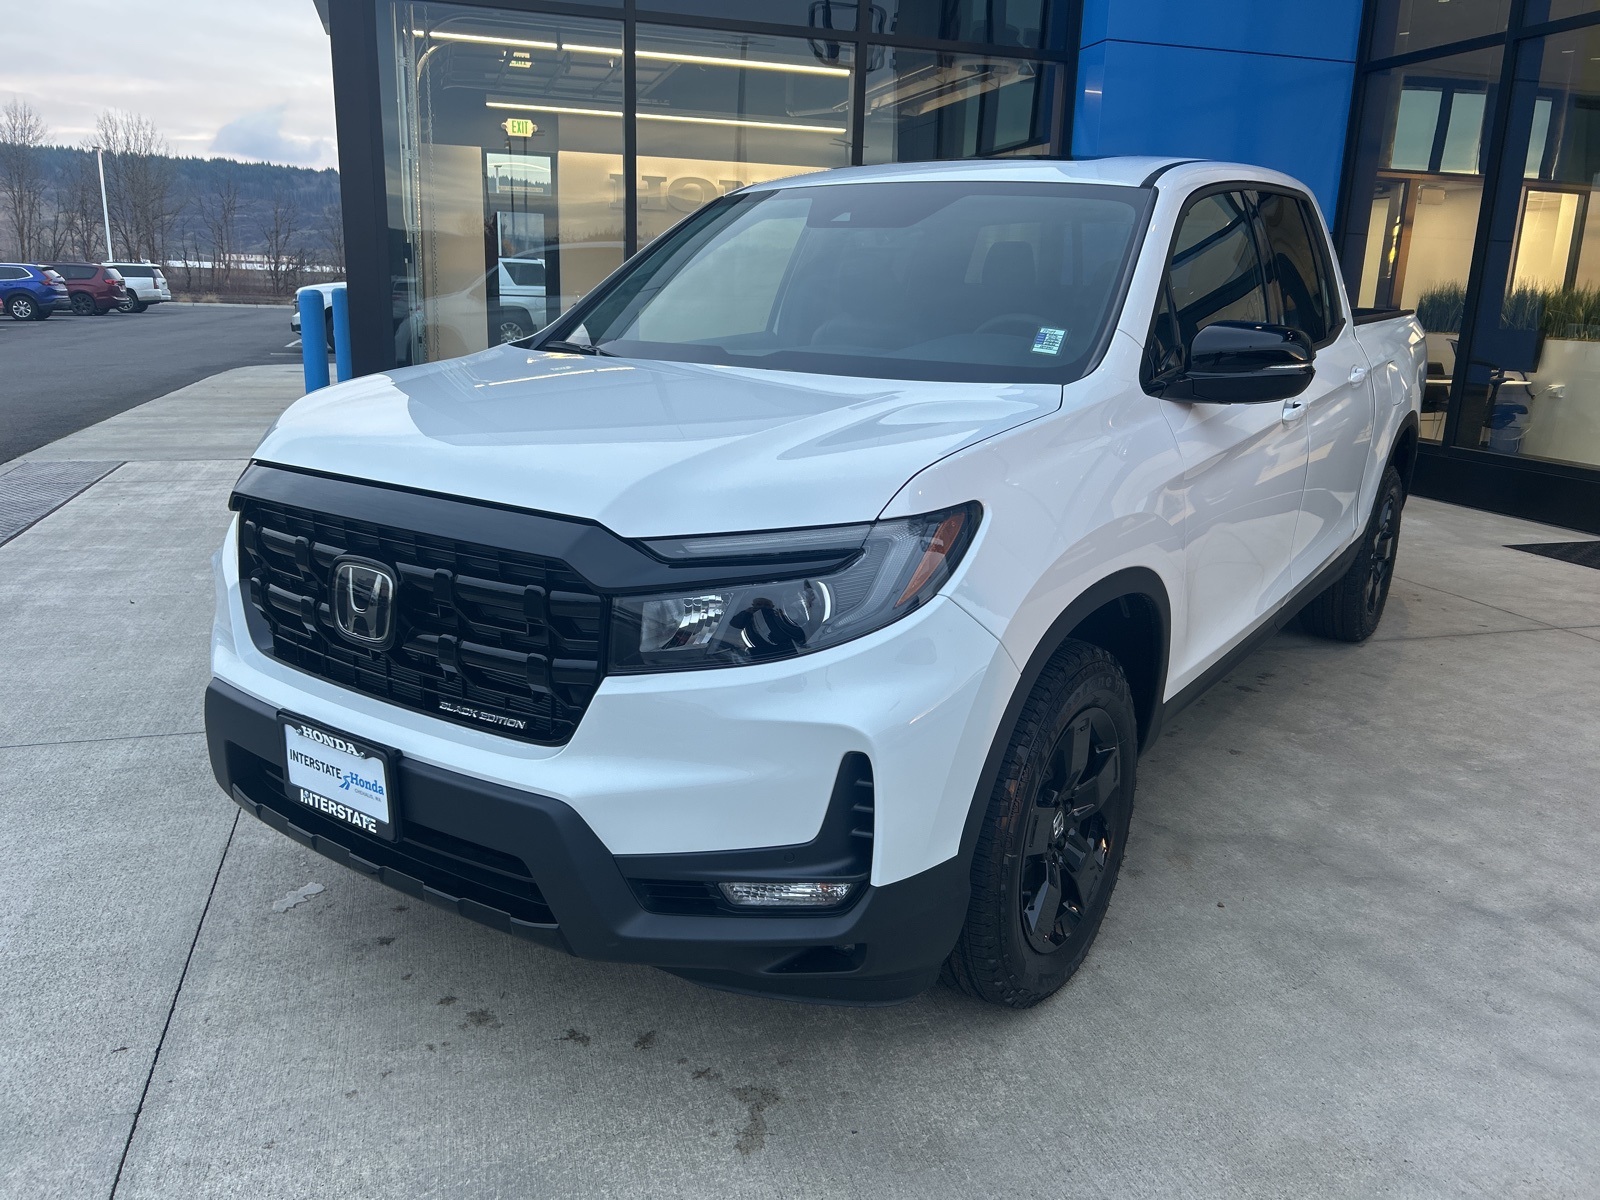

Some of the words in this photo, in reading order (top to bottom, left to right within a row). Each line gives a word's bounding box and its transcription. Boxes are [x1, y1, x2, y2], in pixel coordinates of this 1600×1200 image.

[511, 120, 528, 135] EXIT
[439, 701, 478, 718] BLACK
[479, 711, 526, 730] EDITION
[300, 725, 360, 757] HONDA
[289, 748, 342, 780] INTERSTATE
[349, 771, 385, 796] Honda
[300, 788, 377, 834] INTERSTATE
